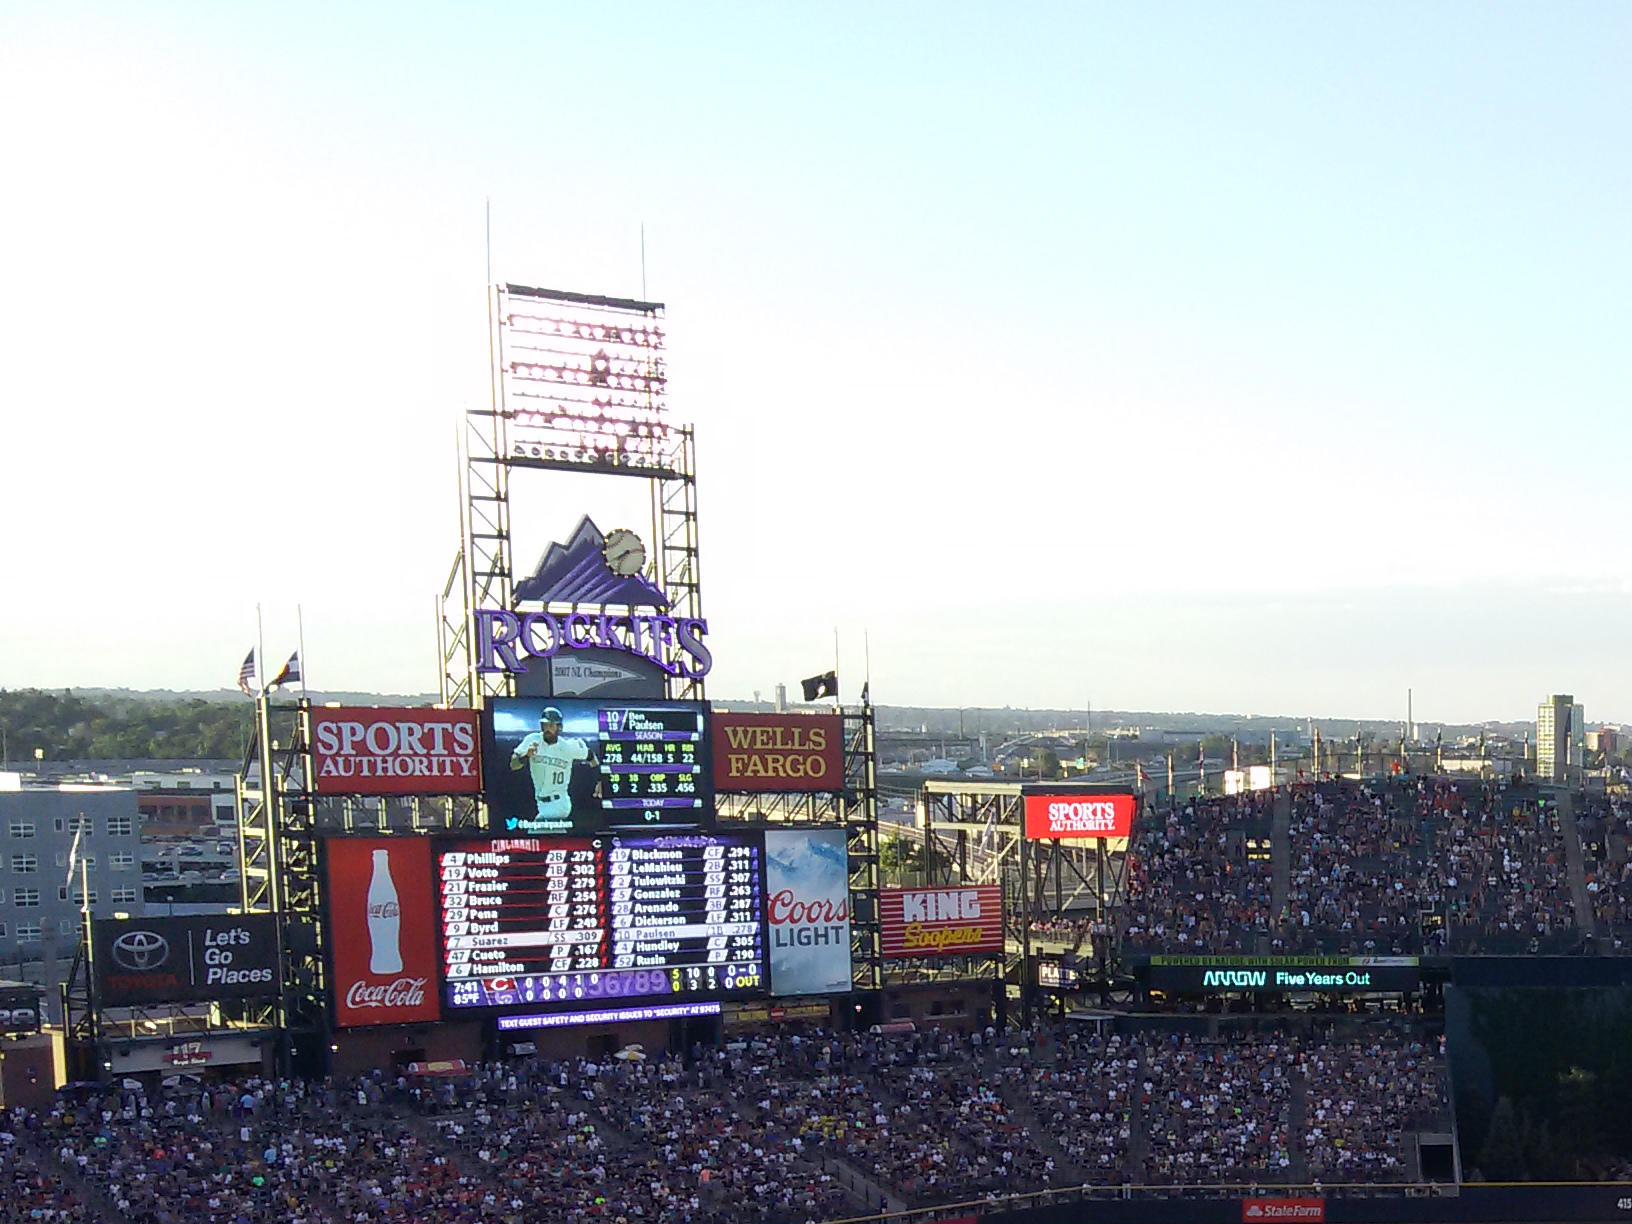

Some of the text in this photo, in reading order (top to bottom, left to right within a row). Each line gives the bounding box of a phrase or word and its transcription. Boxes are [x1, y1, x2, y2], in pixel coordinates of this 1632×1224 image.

[473, 608, 713, 679] ROCKIES
[606, 712, 645, 722] 10 Ben
[629, 720, 663, 730] Paulsen
[317, 722, 474, 755] SPORTS
[635, 731, 663, 740] SEASON
[724, 726, 827, 751] WELLS
[602, 753, 694, 764] .278 44/158 5 22
[728, 753, 827, 778] FARGO
[645, 811, 660, 820] 0-1
[1048, 802, 1114, 821] SPORTS
[467, 853, 510, 866] Phillips
[632, 849, 682, 859] Blackmon
[467, 868, 499, 878] Votto
[632, 862, 682, 873] LeMahieu
[633, 874, 685, 886] Tulowitzki
[469, 881, 509, 892] Frazier
[634, 888, 681, 899] Gonzalez
[469, 895, 503, 906] Bruce
[903, 891, 980, 922] KING
[634, 901, 679, 913] Arenado
[767, 889, 849, 926] Coors
[470, 909, 498, 919] Pena
[635, 915, 686, 927] Dickerson
[471, 922, 499, 935] Byrd
[636, 929, 676, 940] Paulsen
[204, 928, 251, 946] Let's
[472, 936, 508, 946] Suarez
[775, 926, 844, 947] LIGHT
[903, 921, 983, 953] Soopers
[636, 939, 680, 952] Hundley
[204, 947, 233, 965] Go
[472, 950, 505, 961] Cueto
[636, 954, 666, 965] Rusin
[473, 963, 524, 975] Hamilton
[108, 973, 177, 989] TOYOTA
[206, 967, 273, 986] Places
[736, 975, 760, 987] OUT
[1276, 971, 1304, 985] Five
[1305, 972, 1343, 985] Years
[1345, 971, 1370, 986] Out
[453, 982, 478, 993] 7:41
[501, 1019, 518, 1028] TEXT
[518, 1017, 542, 1027] GUEST
[543, 1015, 569, 1026] SAFETY
[570, 1013, 585, 1023] AND
[586, 1011, 619, 1022] SECURITY
[619, 1009, 643, 1019] ISSUES
[644, 1009, 653, 1018] TO
[690, 1005, 699, 1014] AT
[1617, 1198, 1632, 1209] 415
